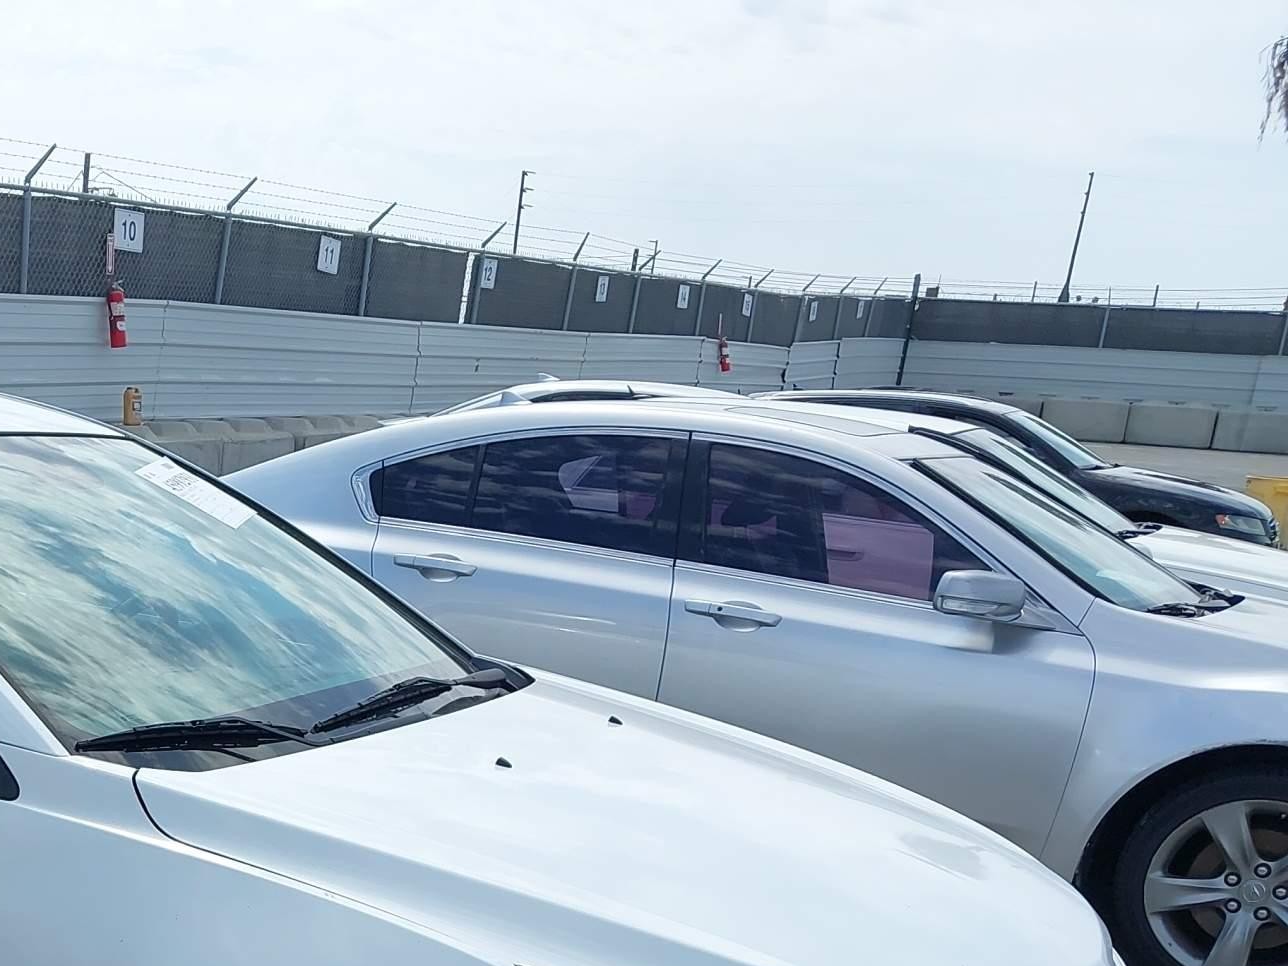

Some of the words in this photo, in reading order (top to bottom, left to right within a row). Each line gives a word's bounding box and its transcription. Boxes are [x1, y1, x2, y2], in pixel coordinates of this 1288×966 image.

[121, 219, 137, 242] 10
[324, 246, 335, 265] 11
[484, 266, 493, 282] 12
